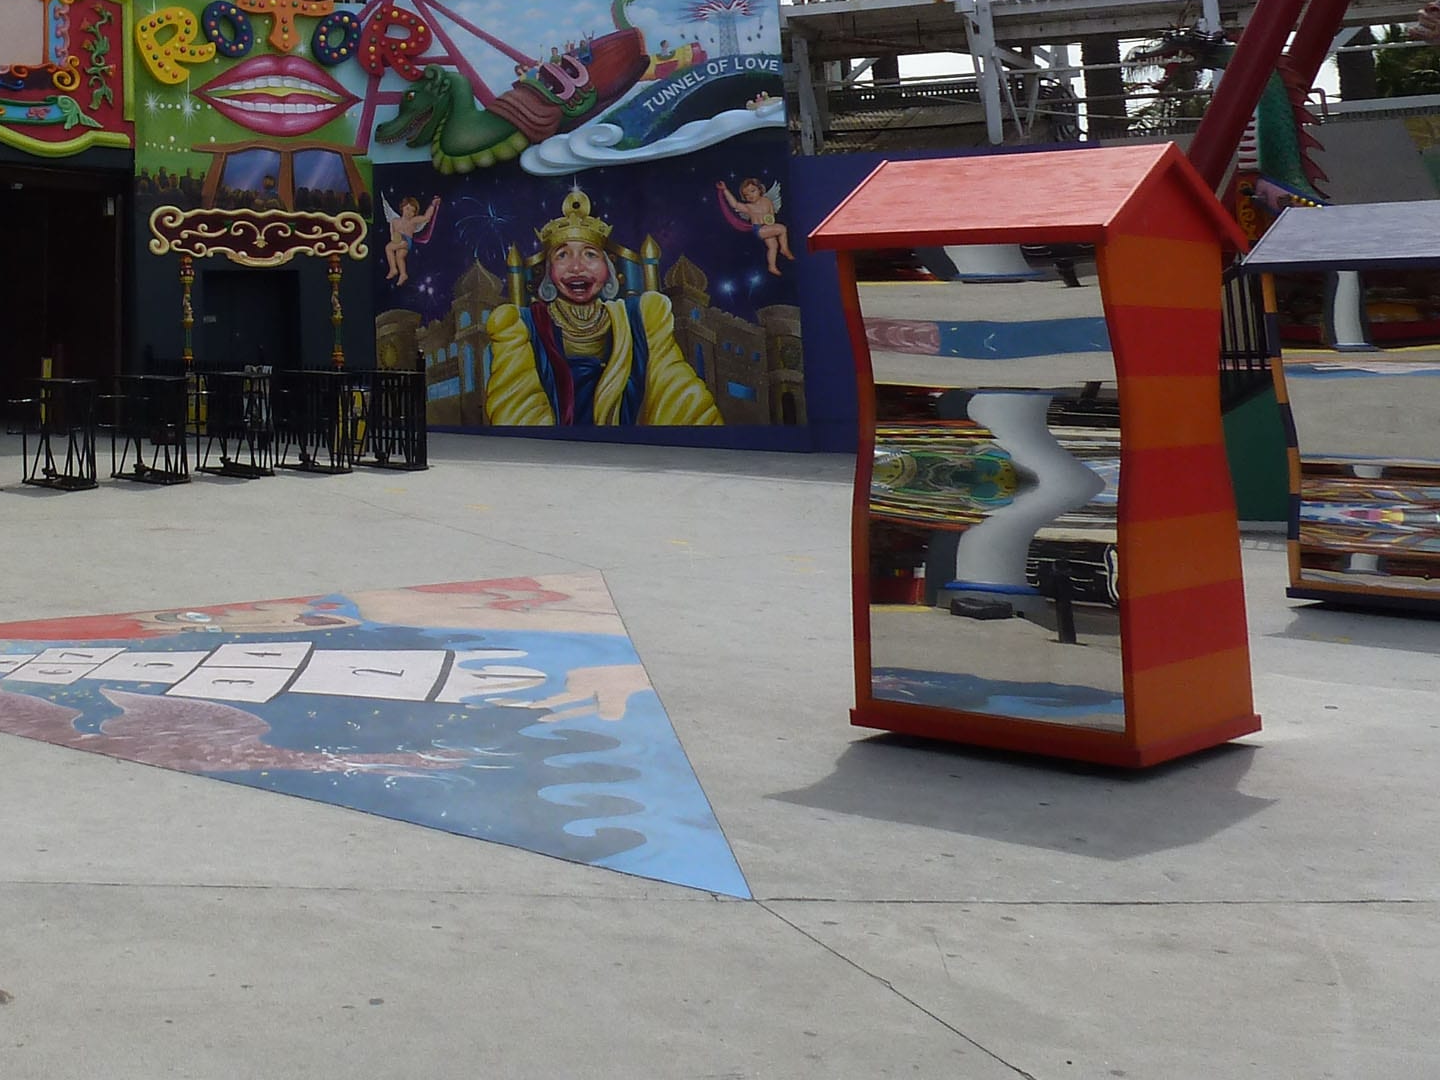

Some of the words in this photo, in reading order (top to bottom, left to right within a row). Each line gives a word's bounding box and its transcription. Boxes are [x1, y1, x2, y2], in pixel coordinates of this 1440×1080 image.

[642, 71, 706, 113] TUNNEL
[707, 59, 729, 75] OF
[735, 57, 780, 72] LOVE
